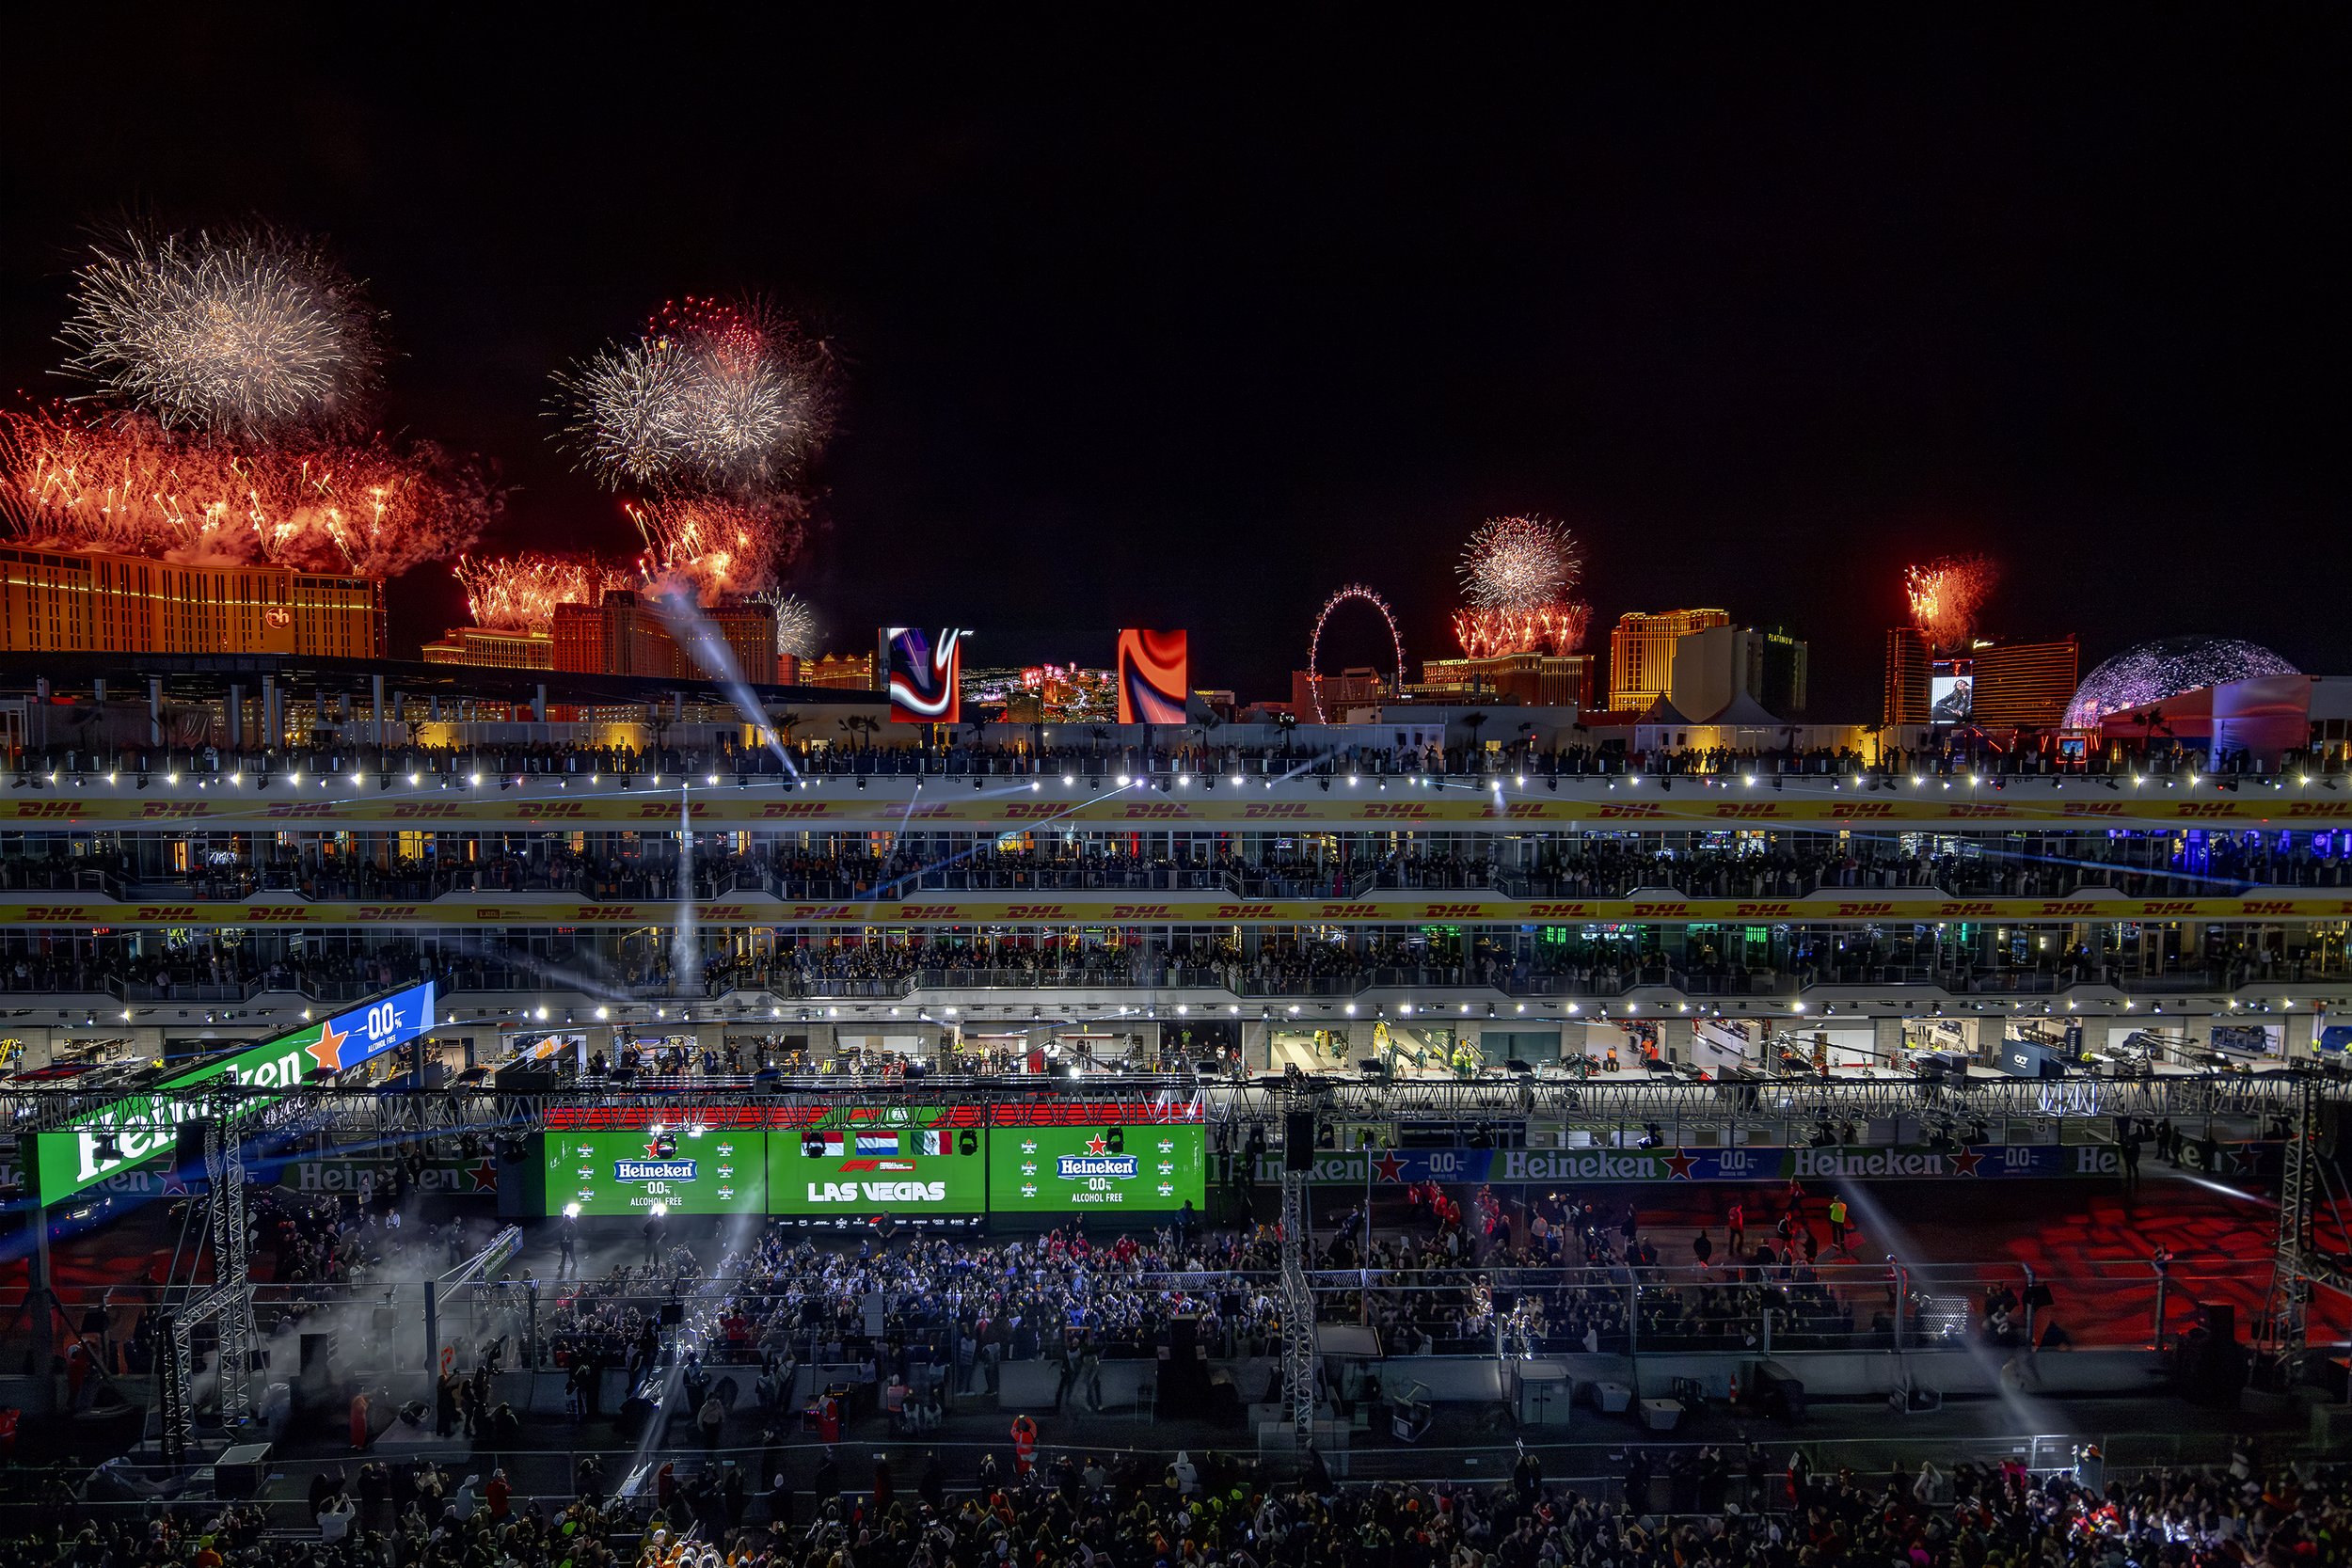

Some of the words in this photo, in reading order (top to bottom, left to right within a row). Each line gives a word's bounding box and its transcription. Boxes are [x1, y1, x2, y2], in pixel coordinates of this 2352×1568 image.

[1768, 633, 1793, 645] PLATINUM
[18, 802, 82, 816] DHL
[143, 802, 208, 816] DHL
[268, 802, 331, 816] DHL
[394, 802, 455, 816] DHL
[517, 803, 582, 817] DHL
[641, 803, 705, 817] DHL
[764, 803, 826, 817] DHL
[885, 803, 953, 817] DHL
[1006, 803, 1071, 817] DHL
[1126, 803, 1190, 817] DHL
[1245, 803, 1307, 817] DHL
[1365, 803, 1431, 817] DHL
[1482, 803, 1548, 817] DHL
[1599, 803, 1664, 817] DHL
[1717, 803, 1781, 817] DHL
[1832, 803, 1891, 817] DHL
[1949, 803, 2009, 817] DHL
[2064, 803, 2122, 817] DHL
[2179, 802, 2234, 816] DHL
[25, 907, 88, 920] DHL
[137, 907, 199, 920] DHL
[248, 907, 309, 920] DHL
[358, 906, 417, 919] DHL
[579, 907, 638, 920] DHL
[793, 907, 852, 920] DHL
[900, 907, 960, 920] DHL
[1007, 905, 1065, 918] DHL
[1113, 905, 1169, 918] DHL
[1217, 905, 1273, 918] DHL
[1323, 905, 1376, 918] DHL
[1426, 905, 1482, 918] DHL
[1530, 905, 1587, 918] DHL
[1634, 905, 1690, 918] DHL
[1737, 905, 1792, 918] DHL
[1838, 905, 1895, 918] DHL
[1941, 904, 1996, 917] DHL
[2043, 904, 2098, 917] DHL
[2143, 903, 2197, 916] DHL
[2244, 903, 2296, 916] DHL
[368, 1039, 386, 1053] ALCOHOL
[386, 1034, 396, 1045] FREE
[75, 1051, 301, 1182] Heinken
[1061, 1159, 1134, 1174] Heineken
[1503, 1150, 1657, 1180] Heineken
[1792, 1148, 1944, 1176] Heineken
[297, 1163, 460, 1192] Heinen
[618, 1164, 692, 1178] Heineken
[807, 1182, 858, 1202] LAS
[861, 1181, 946, 1202] VEGAS
[1072, 1193, 1104, 1203] ALCOHOL
[1105, 1193, 1123, 1202] FREE
[665, 1197, 683, 1206] FREE
